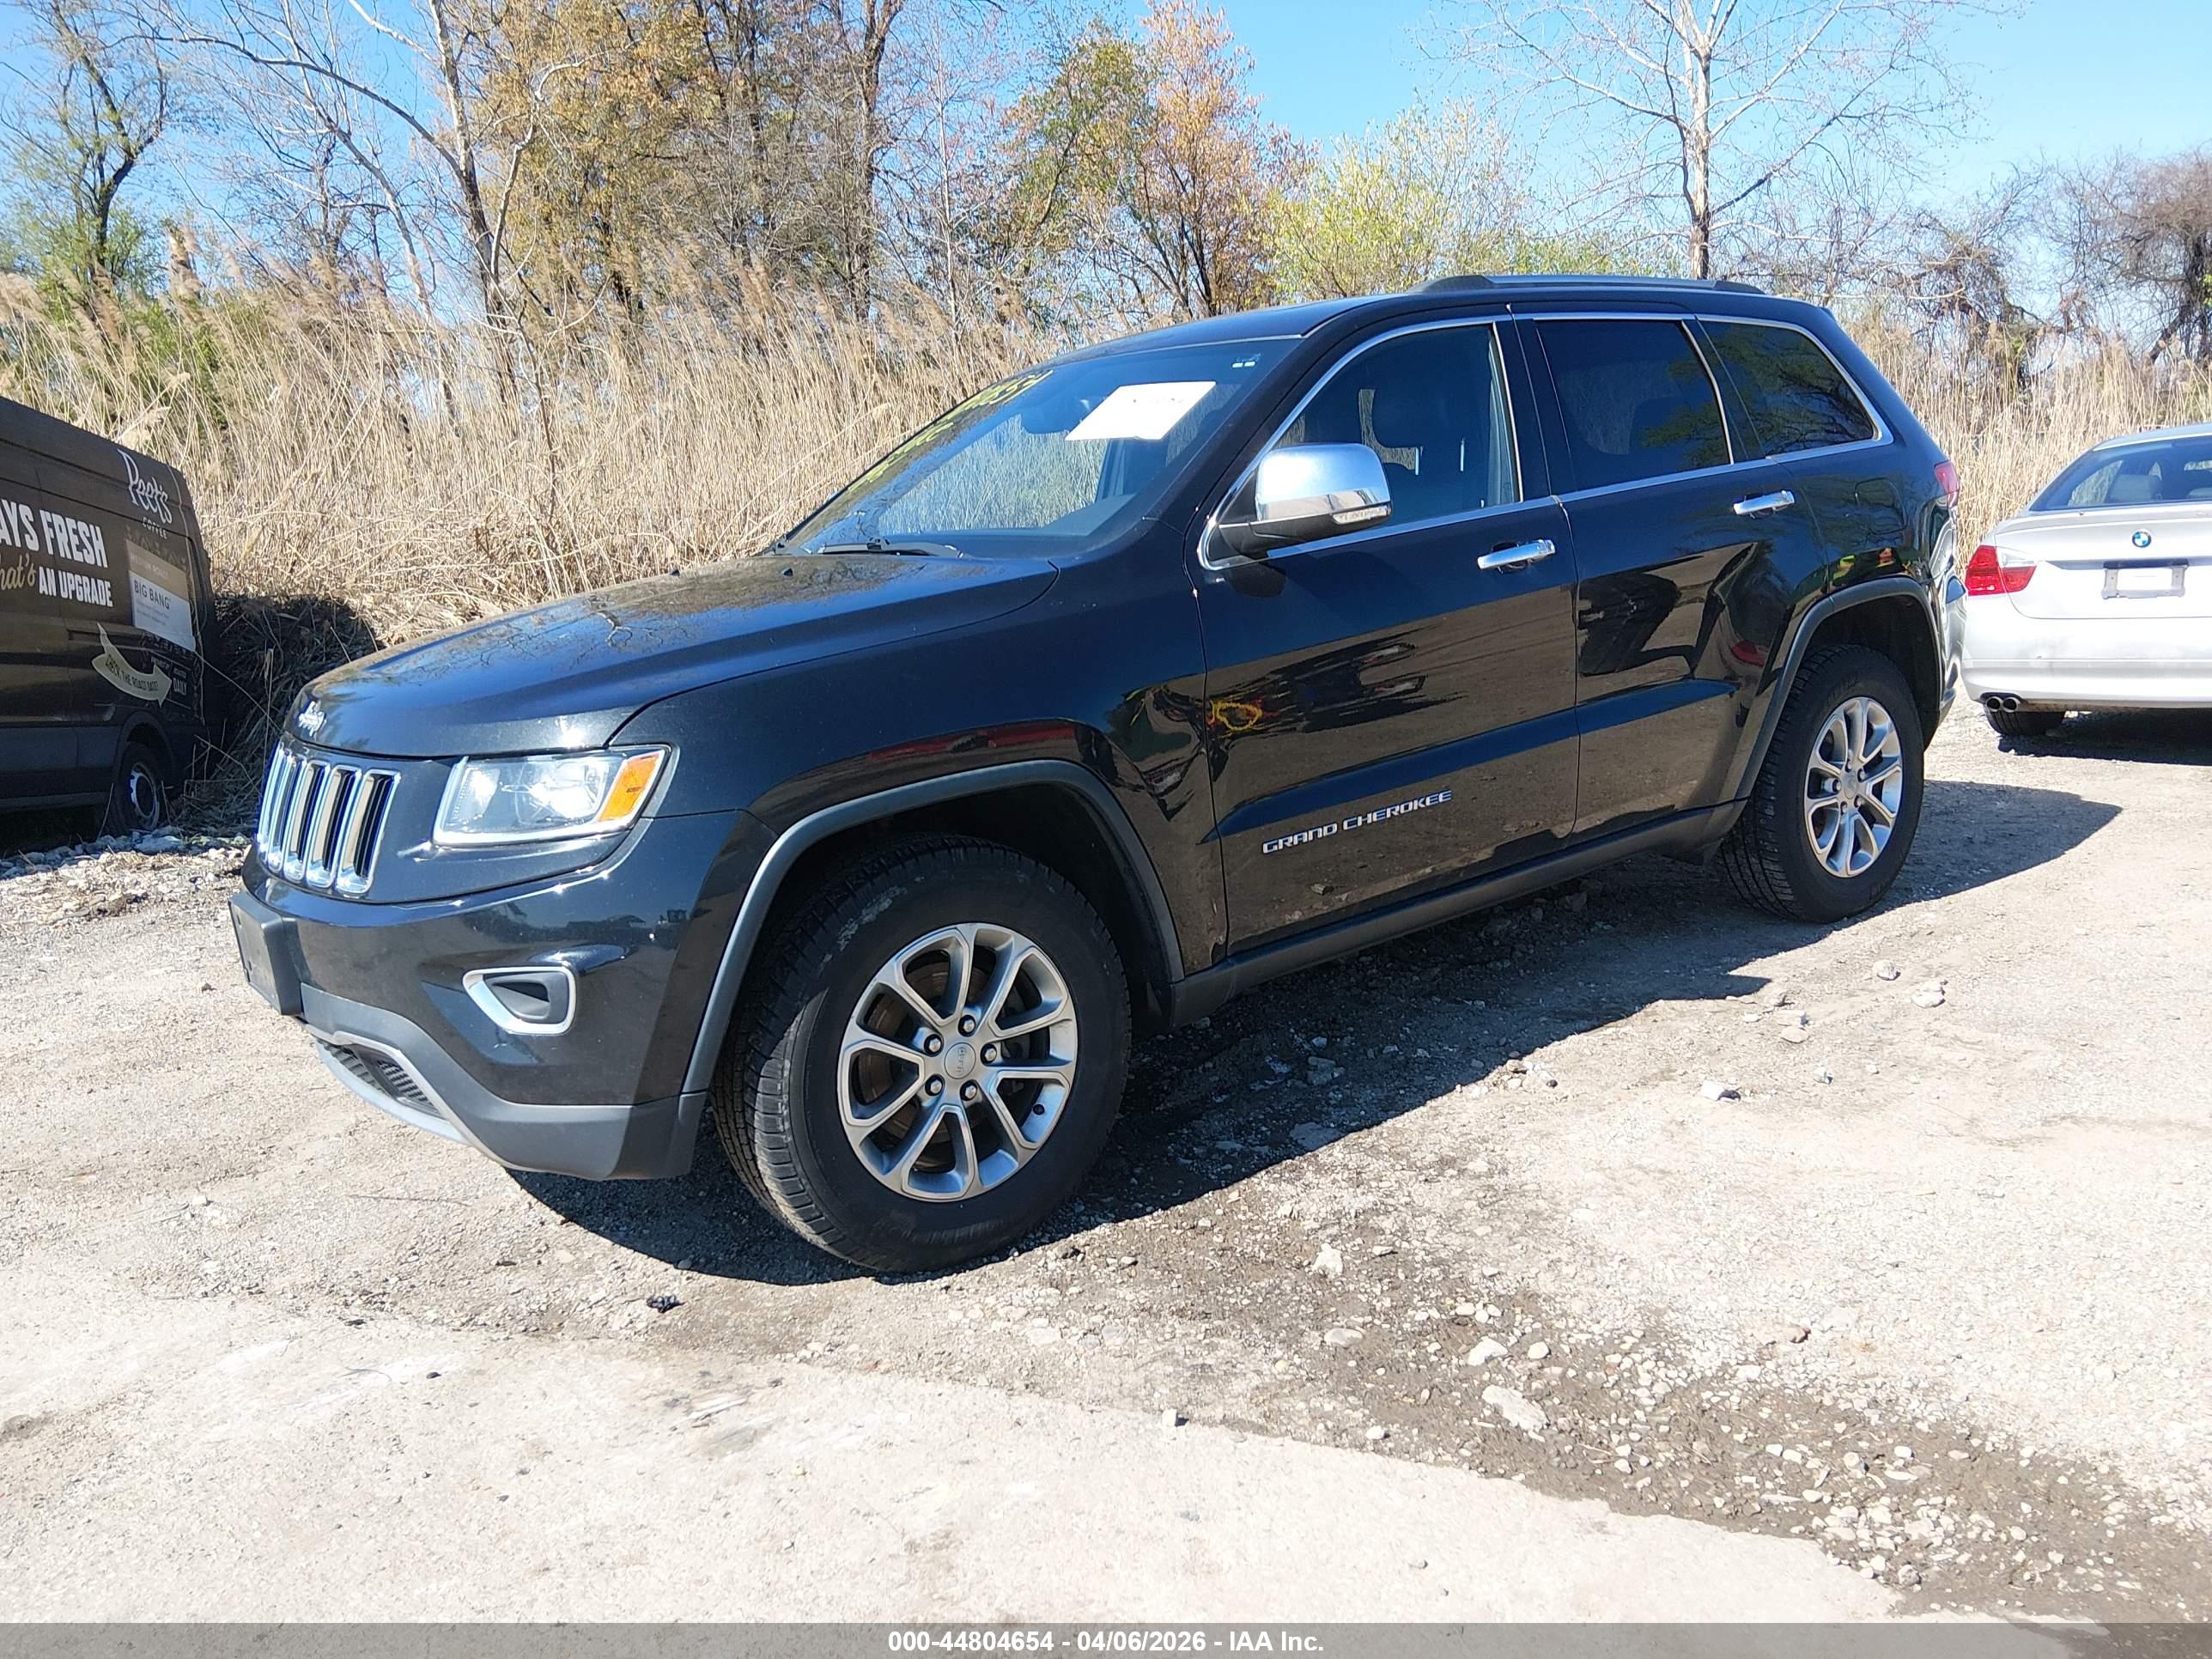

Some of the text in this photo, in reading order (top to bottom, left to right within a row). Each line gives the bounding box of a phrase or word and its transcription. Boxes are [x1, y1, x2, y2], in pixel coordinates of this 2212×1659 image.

[40, 509, 108, 568] FRESH
[39, 566, 57, 597] AN
[58, 569, 113, 607] UPGRADE
[134, 580, 147, 598] BIG
[1261, 789, 1452, 854] GRAND CHEROKEE
